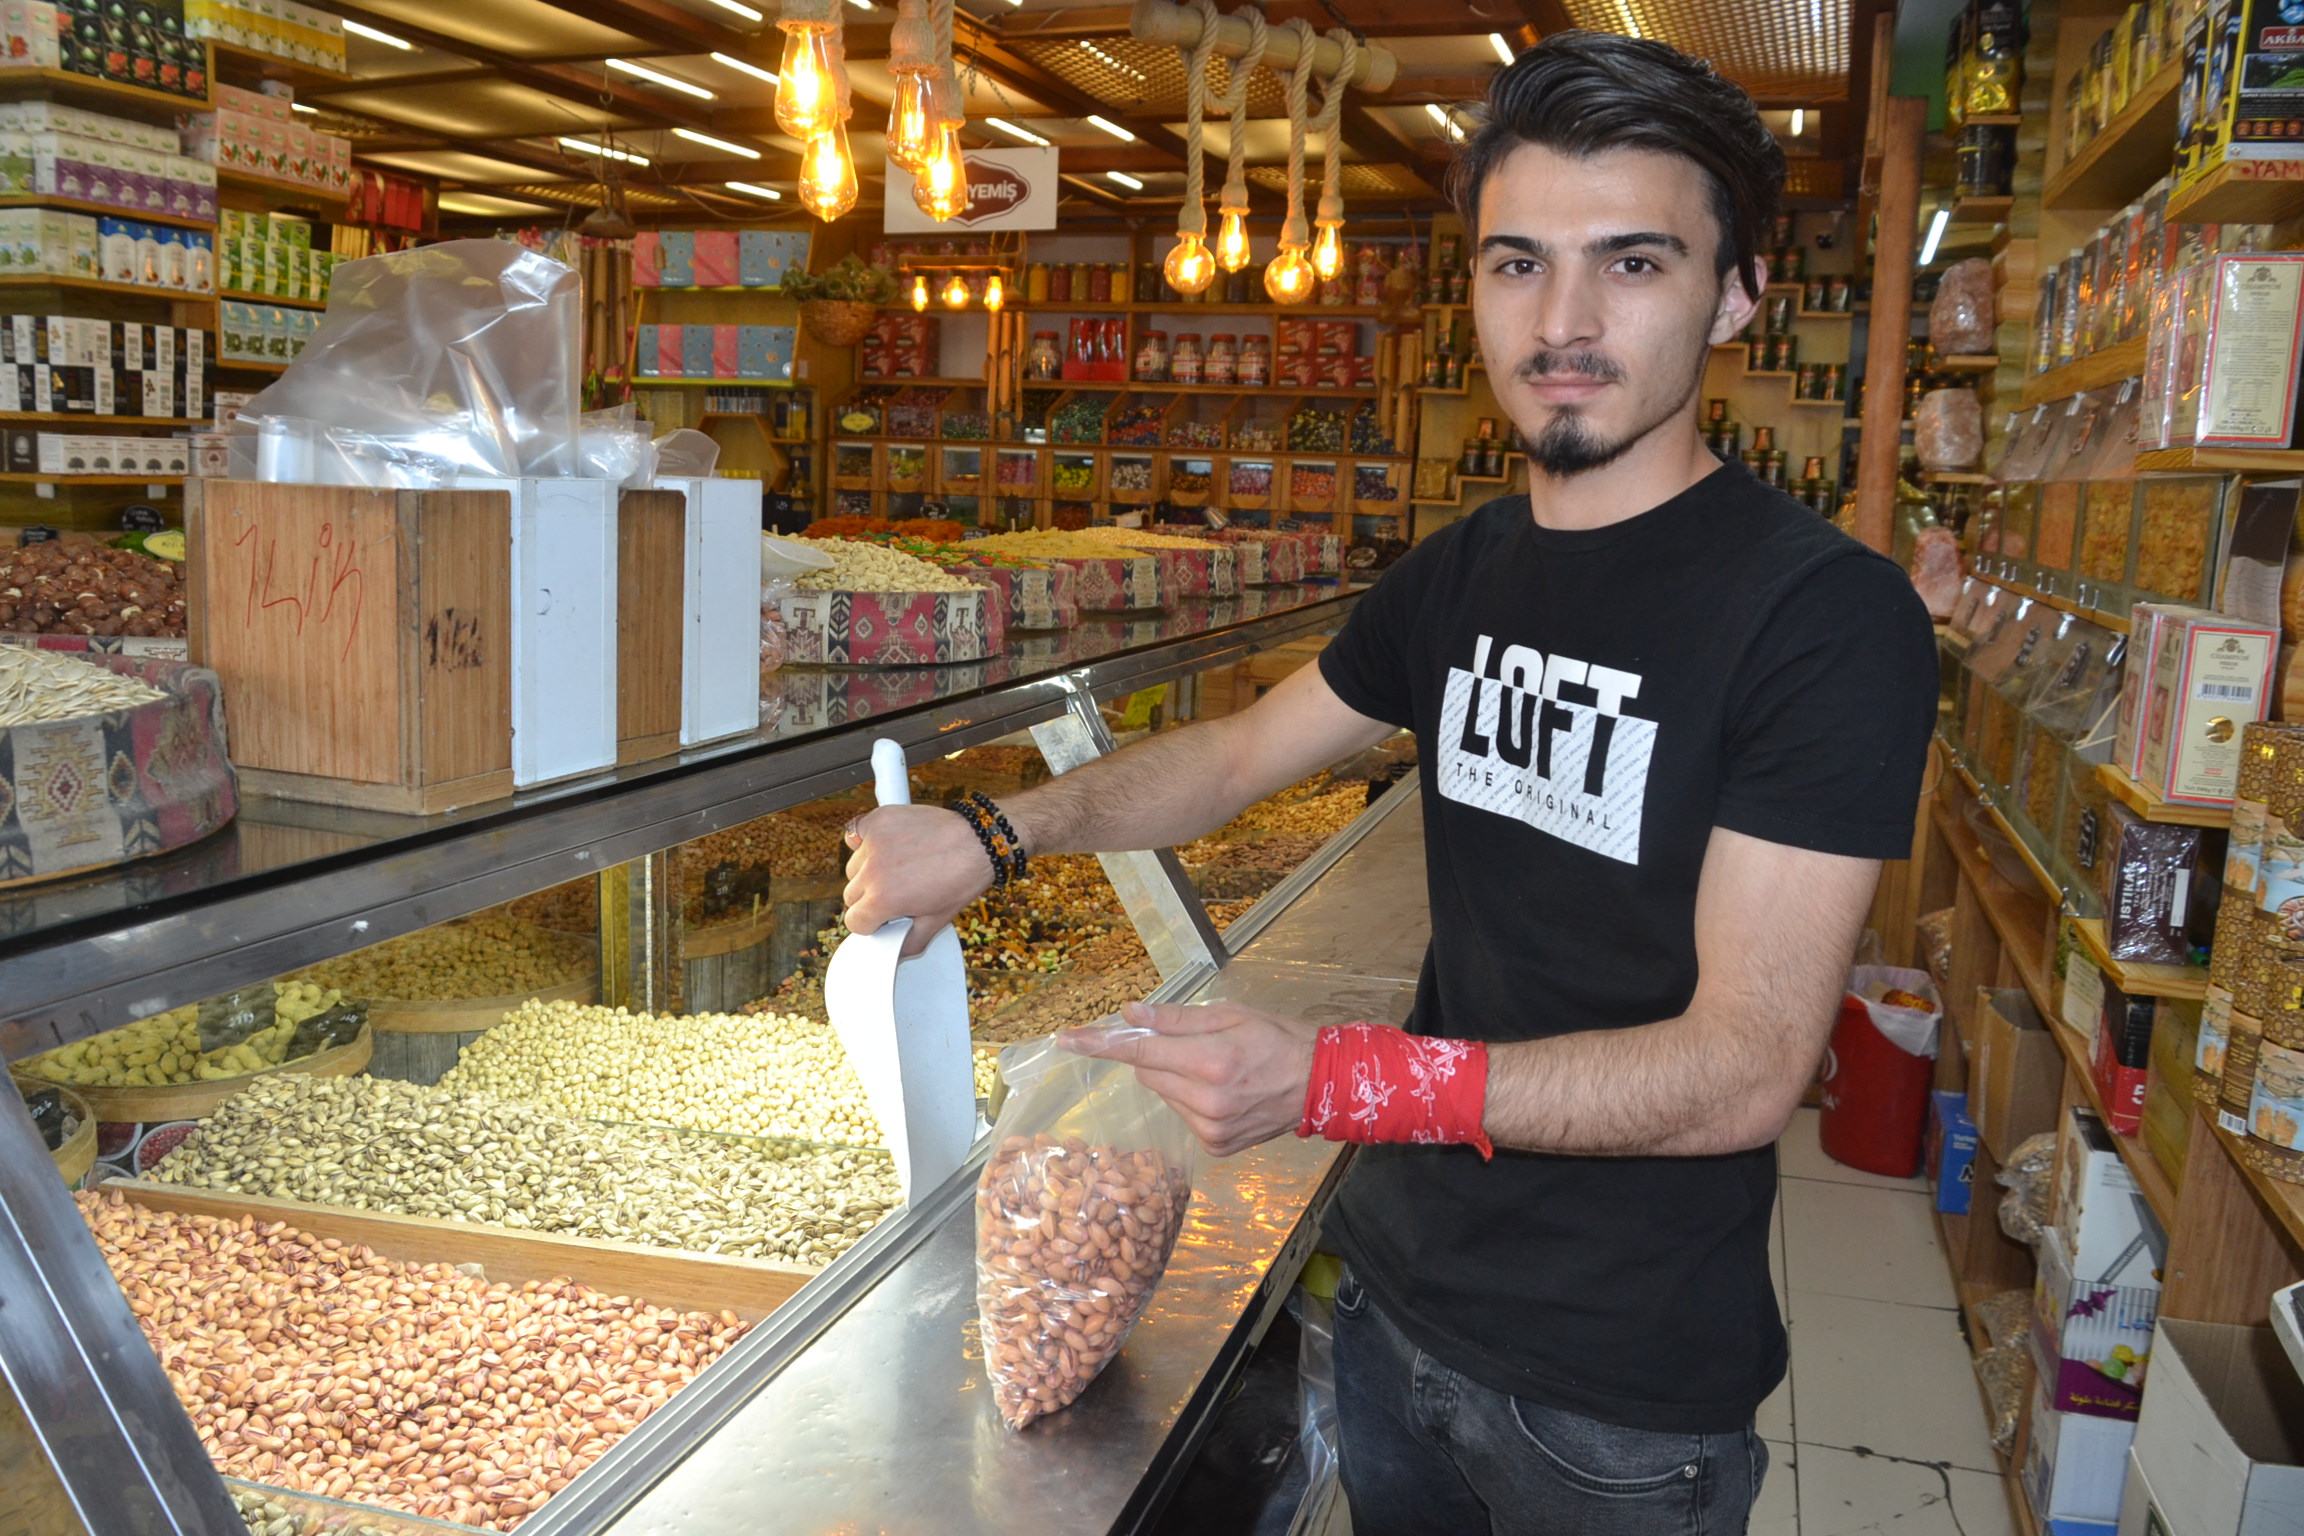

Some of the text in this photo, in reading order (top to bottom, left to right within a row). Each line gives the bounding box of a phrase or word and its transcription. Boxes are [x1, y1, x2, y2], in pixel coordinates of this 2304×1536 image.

[968, 180, 1018, 202] YEMİŞ
[1459, 634, 1642, 798] LOFT
[1457, 762, 1611, 830] THE ORIGINAL
